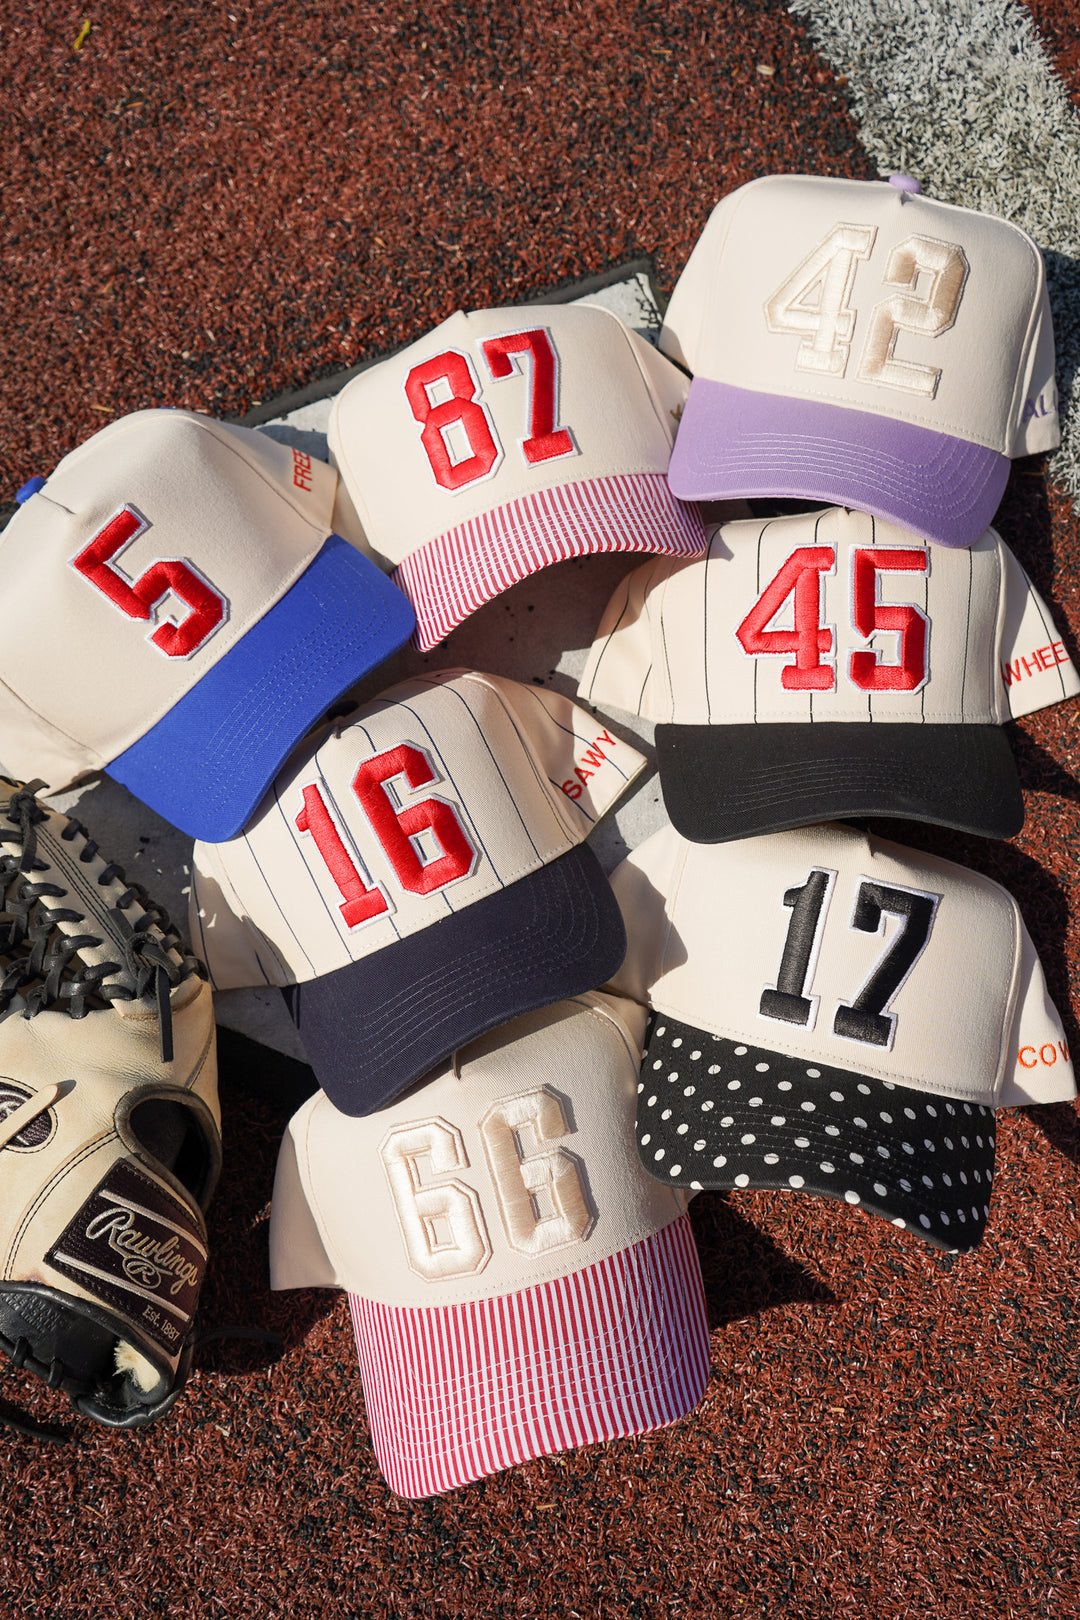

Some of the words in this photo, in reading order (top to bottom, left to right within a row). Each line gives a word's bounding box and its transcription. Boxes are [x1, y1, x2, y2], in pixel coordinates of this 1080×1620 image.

[763, 222, 970, 400] 42
[401, 326, 581, 496] 87
[1022, 390, 1058, 424] AL
[68, 503, 230, 661] 5
[732, 542, 931, 695] 45
[295, 739, 482, 933] 16
[756, 866, 940, 1051] 17
[86, 1207, 198, 1295] Rawlings
[377, 1083, 594, 1283] 66
[142, 1304, 161, 1327] Est.
[160, 1319, 180, 1342] 1887
